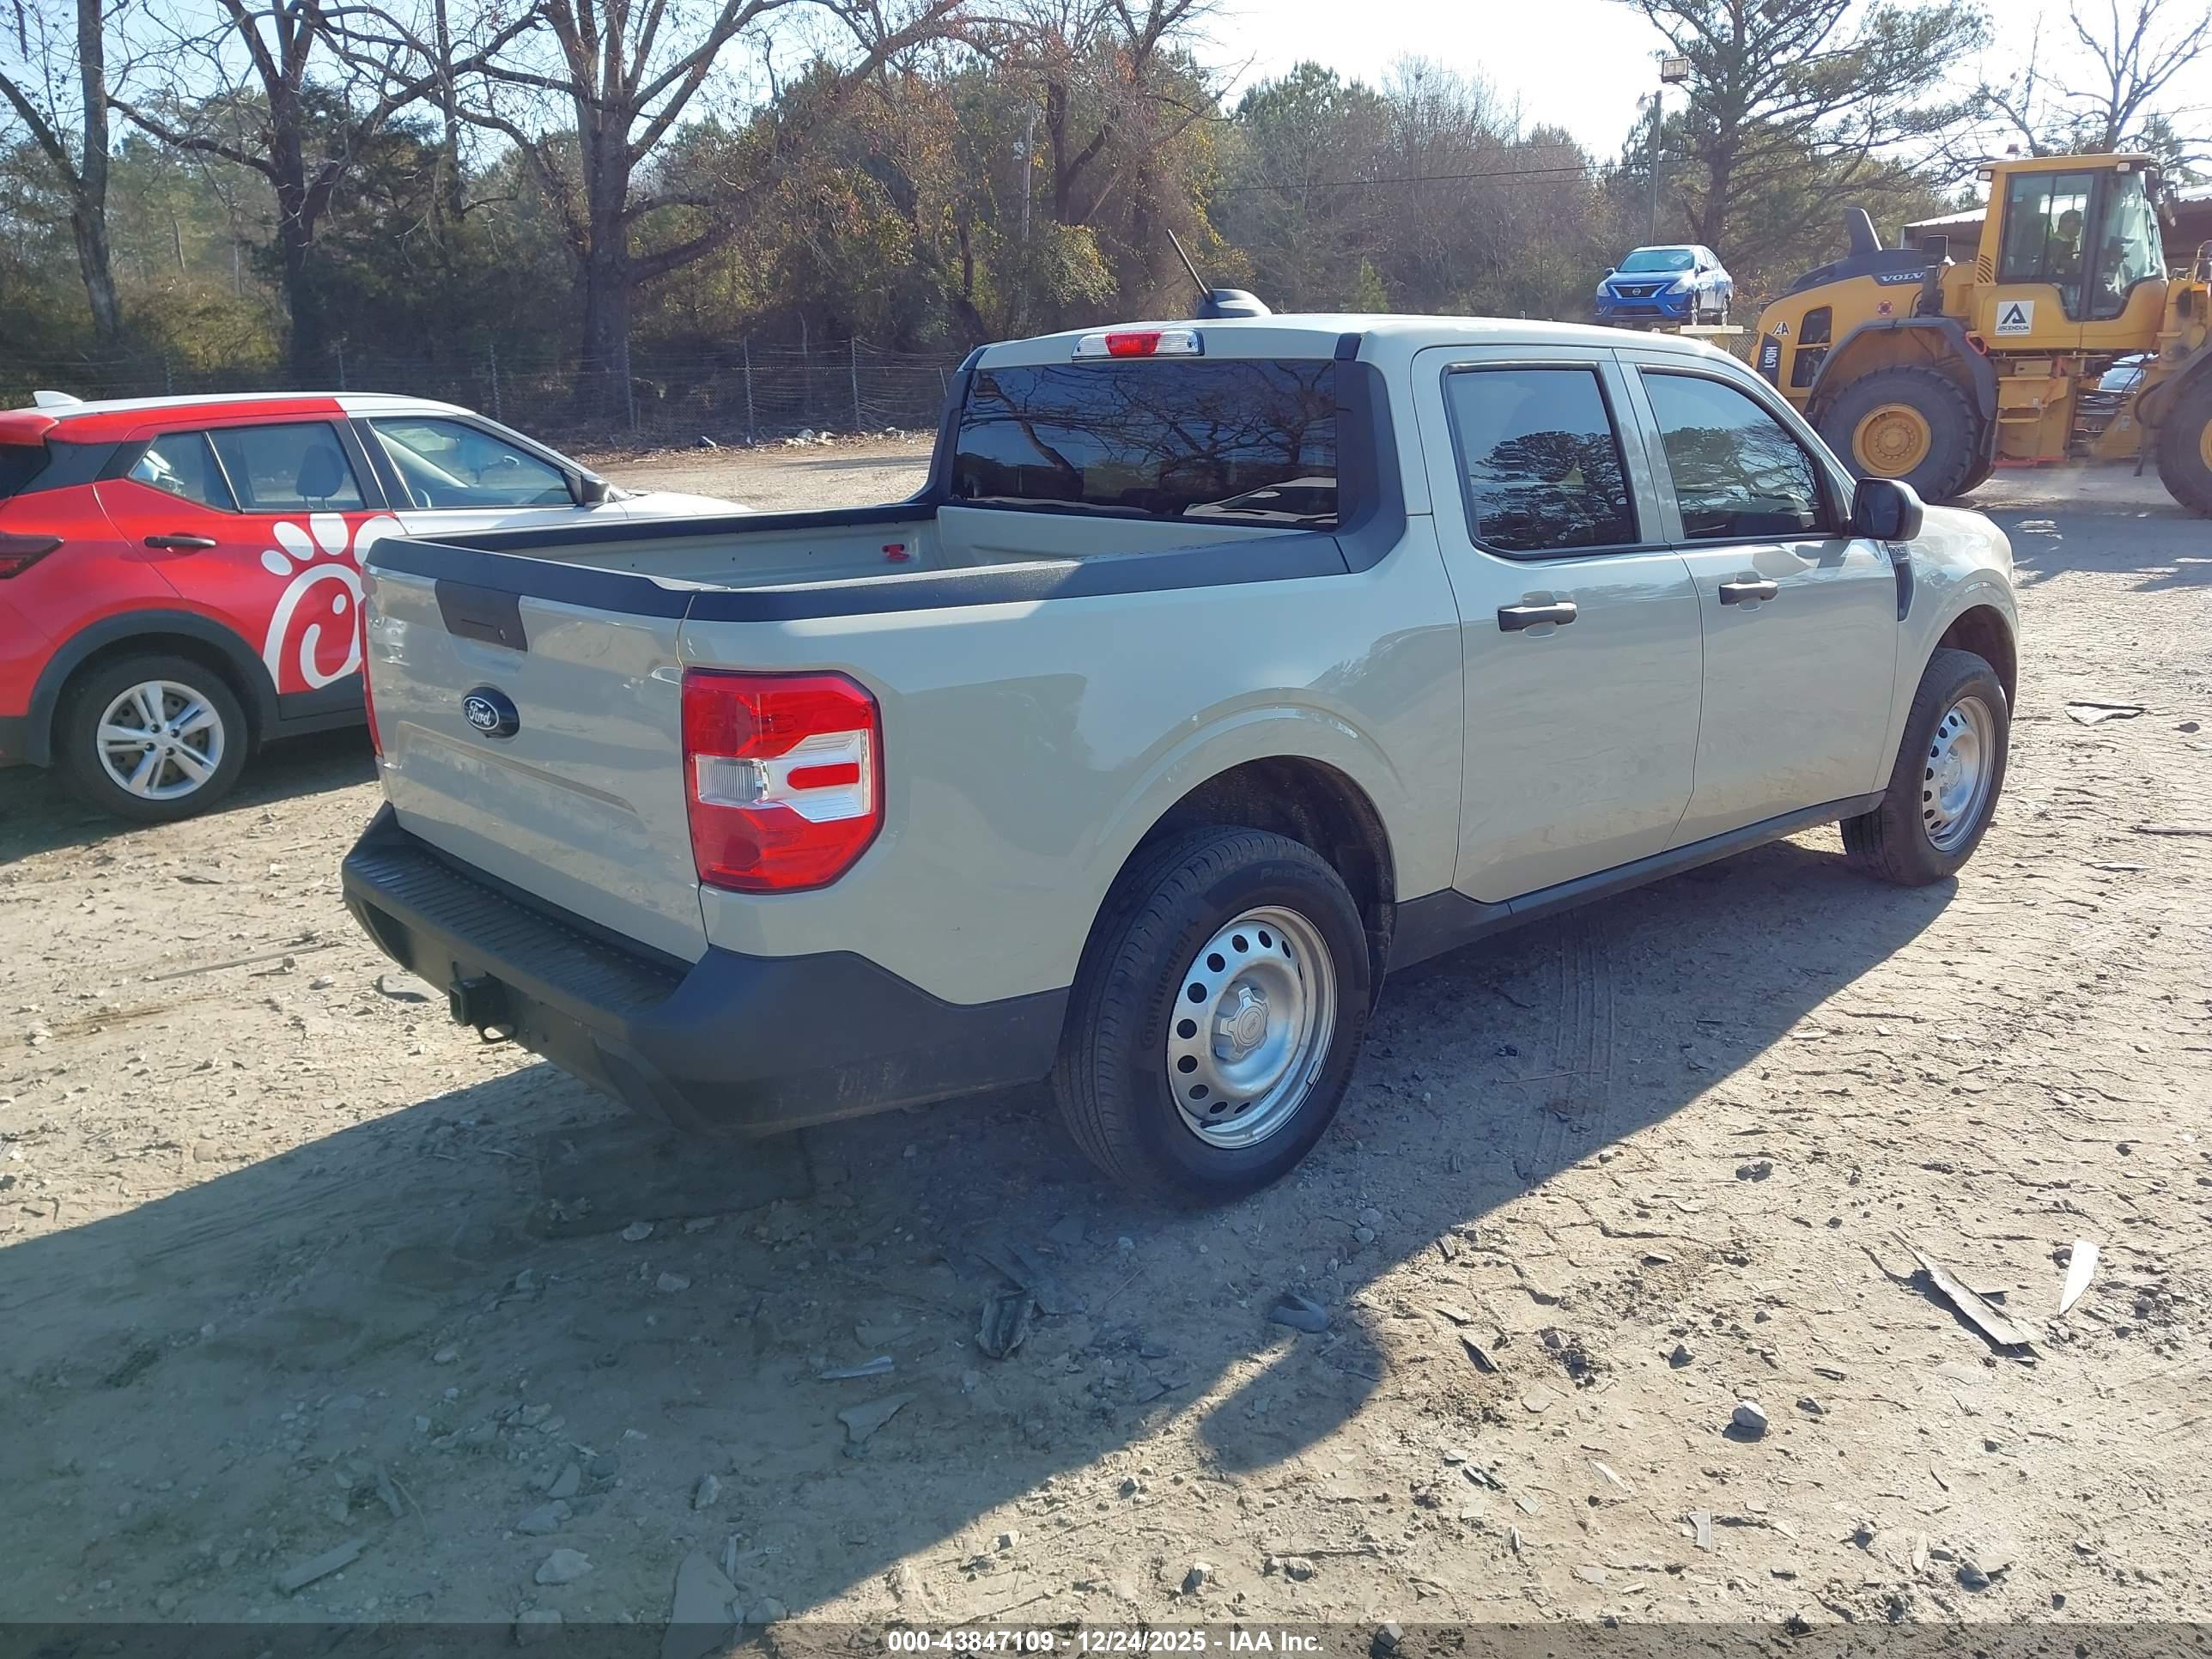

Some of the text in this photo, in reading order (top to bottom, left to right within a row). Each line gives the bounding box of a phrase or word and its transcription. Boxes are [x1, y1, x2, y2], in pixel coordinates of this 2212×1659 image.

[1881, 272, 1925, 282] VOLV
[1764, 346, 1778, 368] L90H
[468, 700, 492, 726] Ford
[1140, 927, 1193, 1052] Continental
